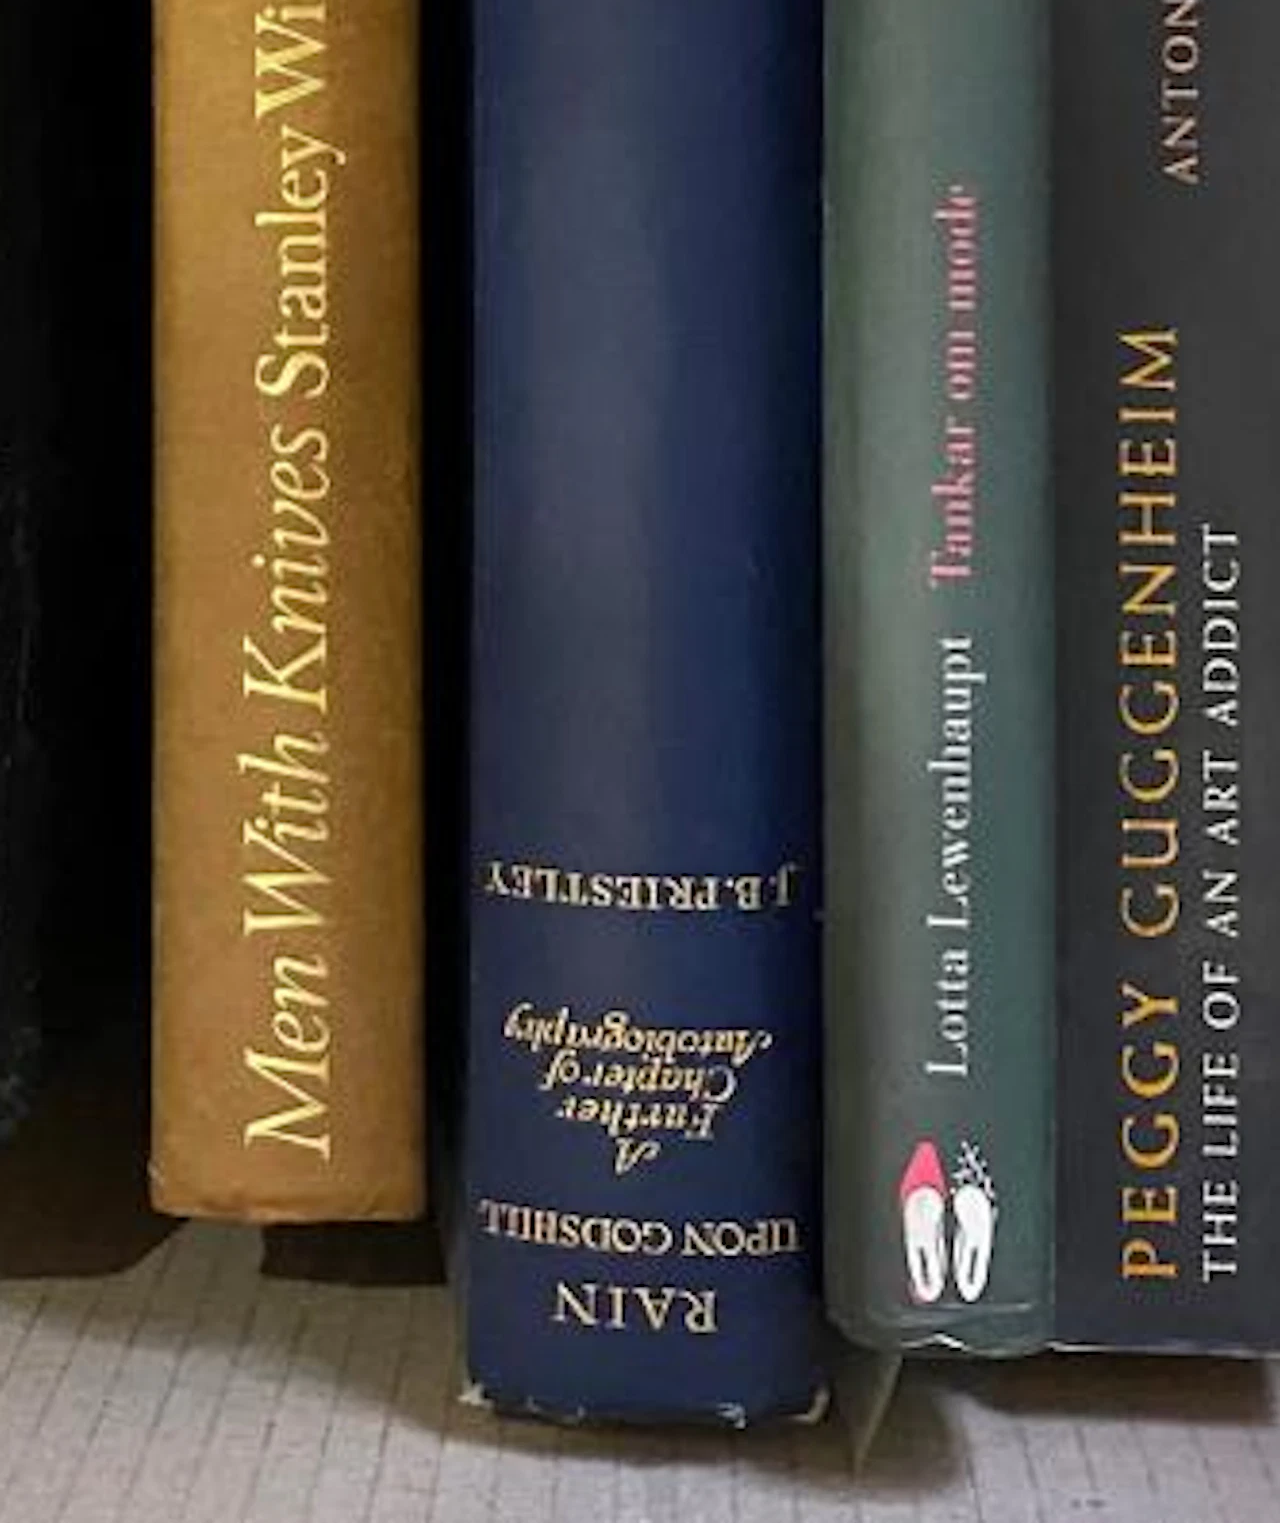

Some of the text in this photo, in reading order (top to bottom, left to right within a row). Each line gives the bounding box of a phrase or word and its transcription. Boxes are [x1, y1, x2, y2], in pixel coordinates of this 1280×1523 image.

[254, 124, 347, 398] Stanley
[943, 329, 976, 401] om
[242, 424, 332, 717] Knives
[928, 415, 976, 591] Tankar
[237, 729, 331, 935] With
[923, 634, 988, 1078] Lotta Lewenhaupt
[1117, 326, 1182, 1282] PEGGY GUGGENHEIM
[1200, 522, 1241, 1282] THE LIFE OF AN ART ADDICT
[242, 955, 332, 1162] Men
[501, 1002, 774, 1069] Autobiography
[538, 1049, 737, 1104] Chapter of
[554, 1098, 720, 1142] Further
[478, 1197, 802, 1257] UPON GODSHILL
[614, 1138, 661, 1177] A
[552, 1280, 719, 1334] RAIN
